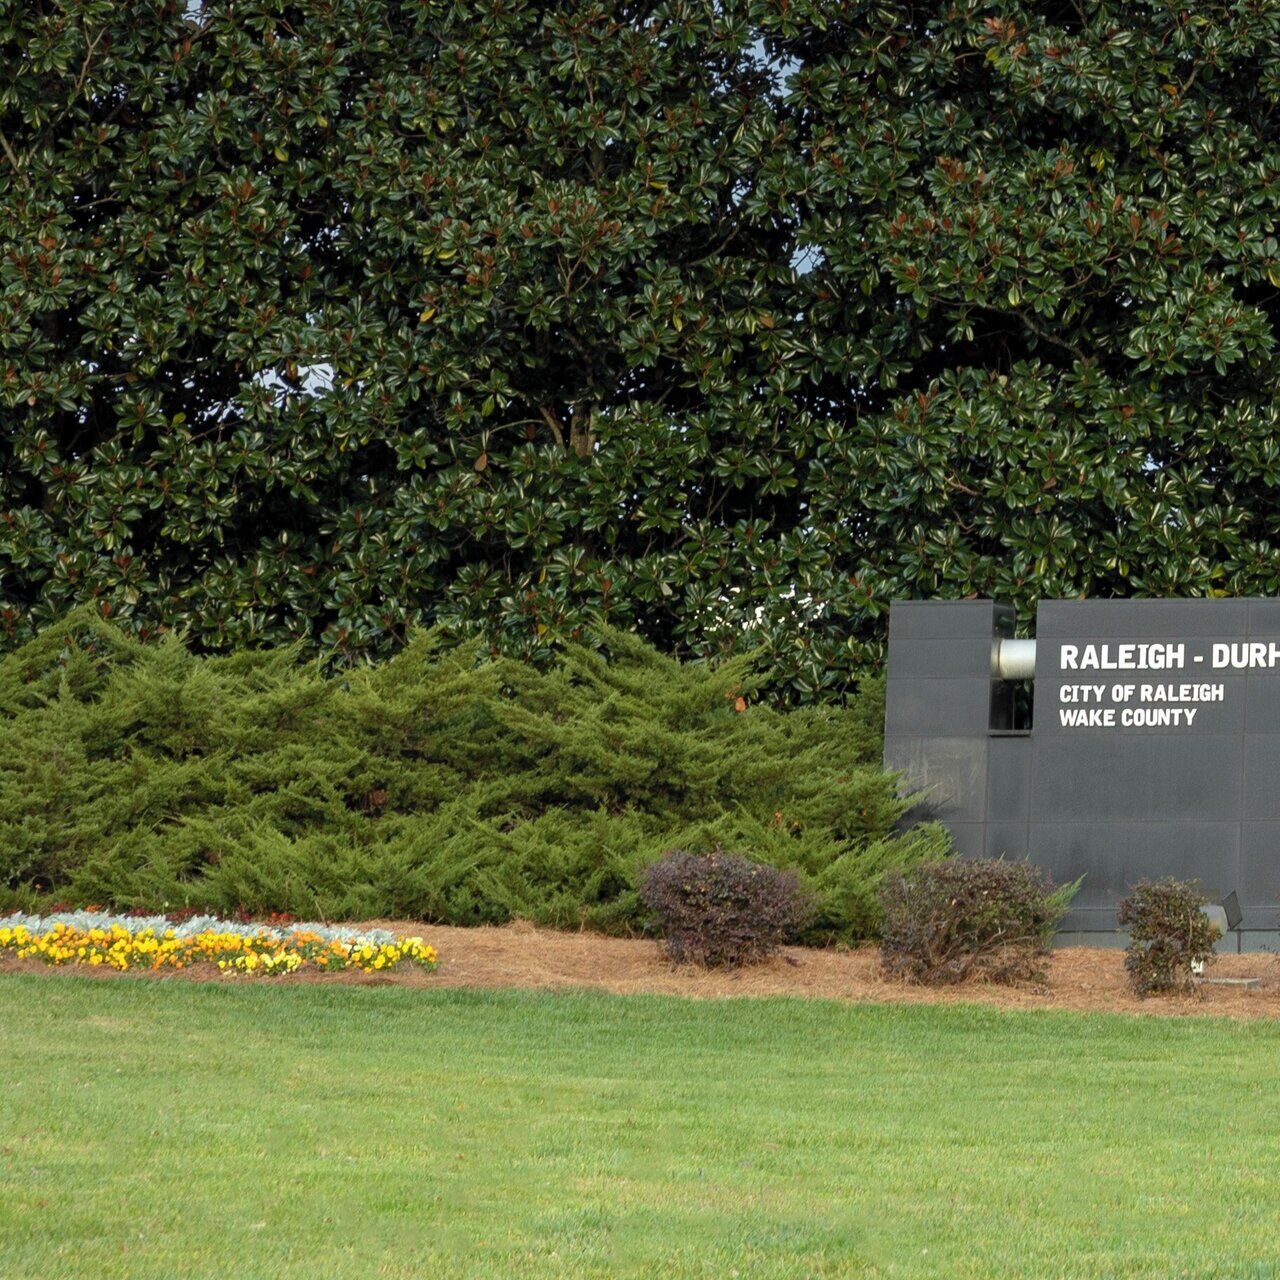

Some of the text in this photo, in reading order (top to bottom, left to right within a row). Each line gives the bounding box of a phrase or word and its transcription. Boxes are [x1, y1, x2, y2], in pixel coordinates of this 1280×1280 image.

[1060, 643, 1185, 670] RALEIGH
[1059, 683, 1225, 703] CITY OF RALEIGH
[1059, 708, 1198, 727] WAKE COUNTY
